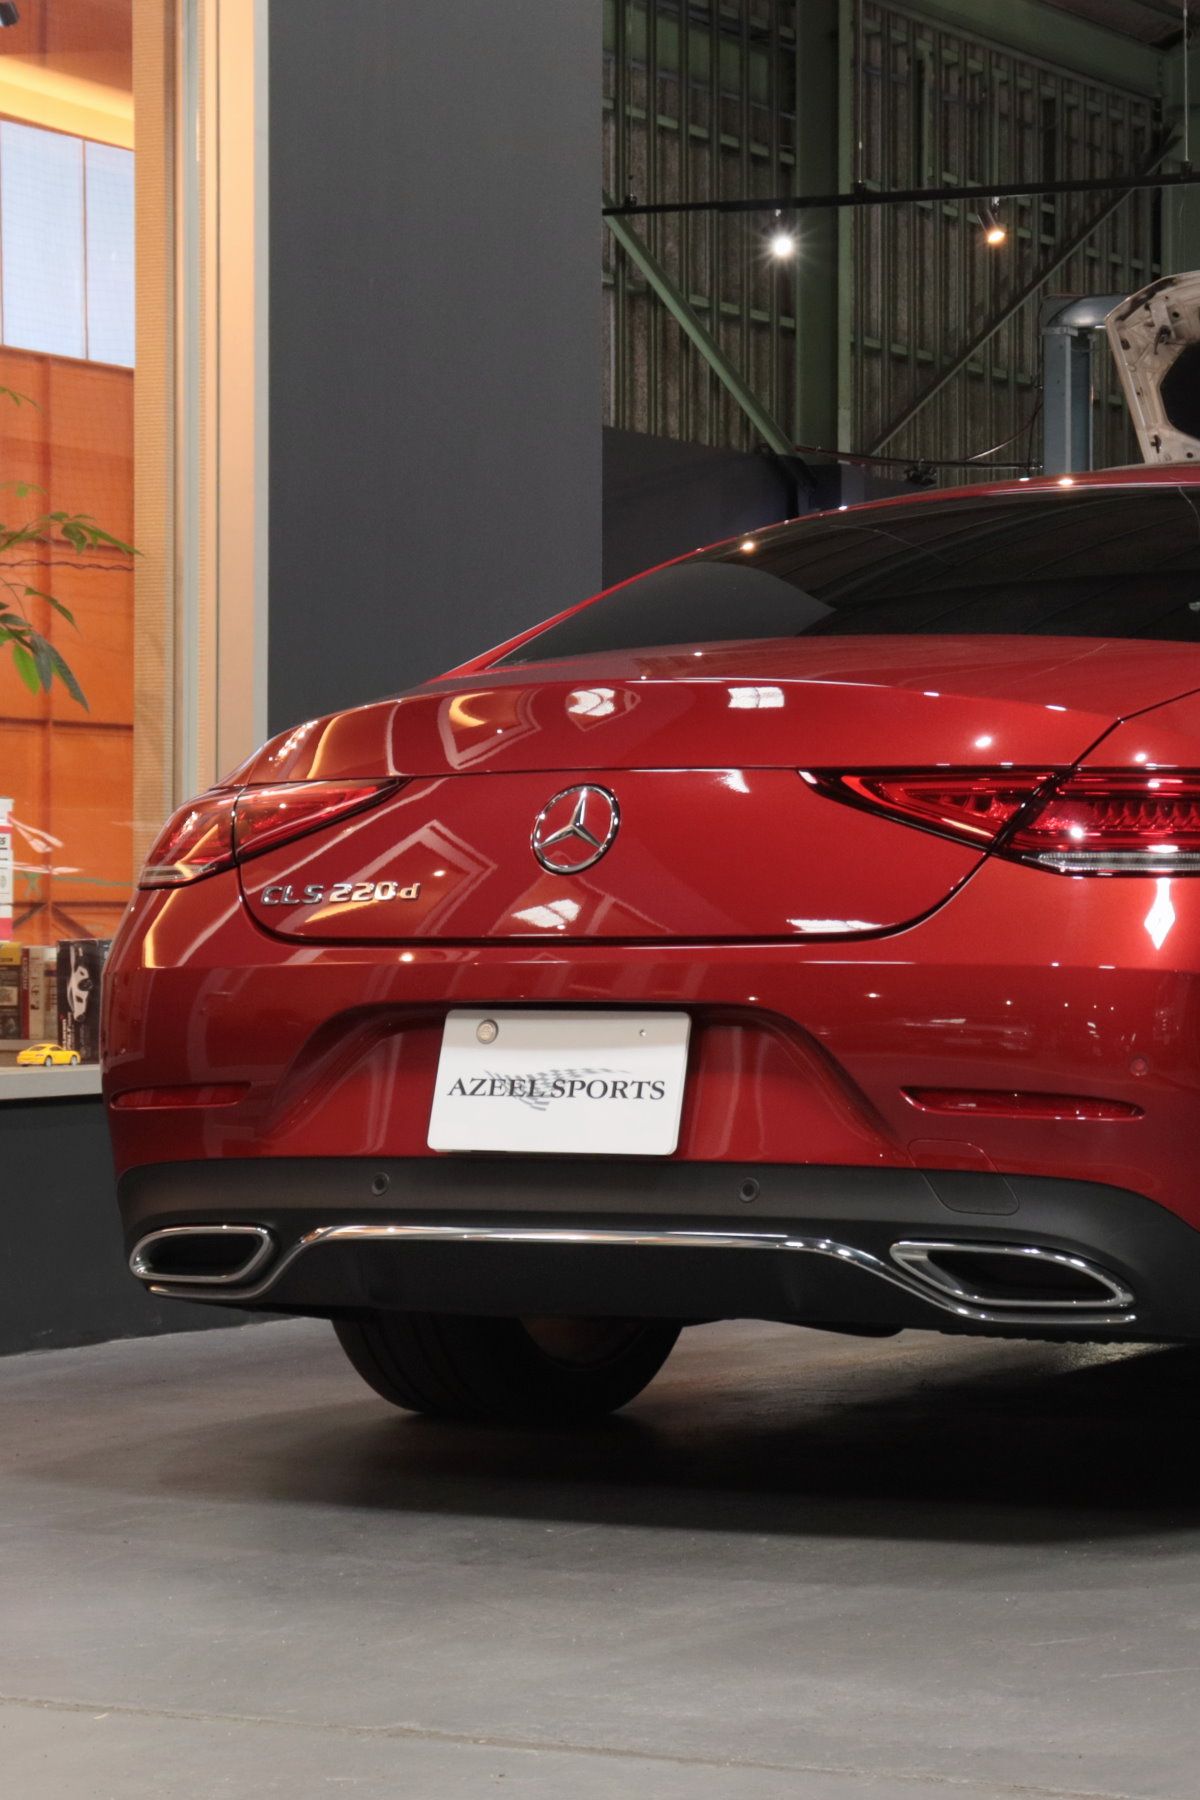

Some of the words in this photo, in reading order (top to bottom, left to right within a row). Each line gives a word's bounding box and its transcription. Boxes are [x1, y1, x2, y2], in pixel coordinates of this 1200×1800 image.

[262, 885, 324, 905] CLS
[446, 1077, 545, 1098] AZEEL
[550, 1079, 666, 1101] SPORTS
